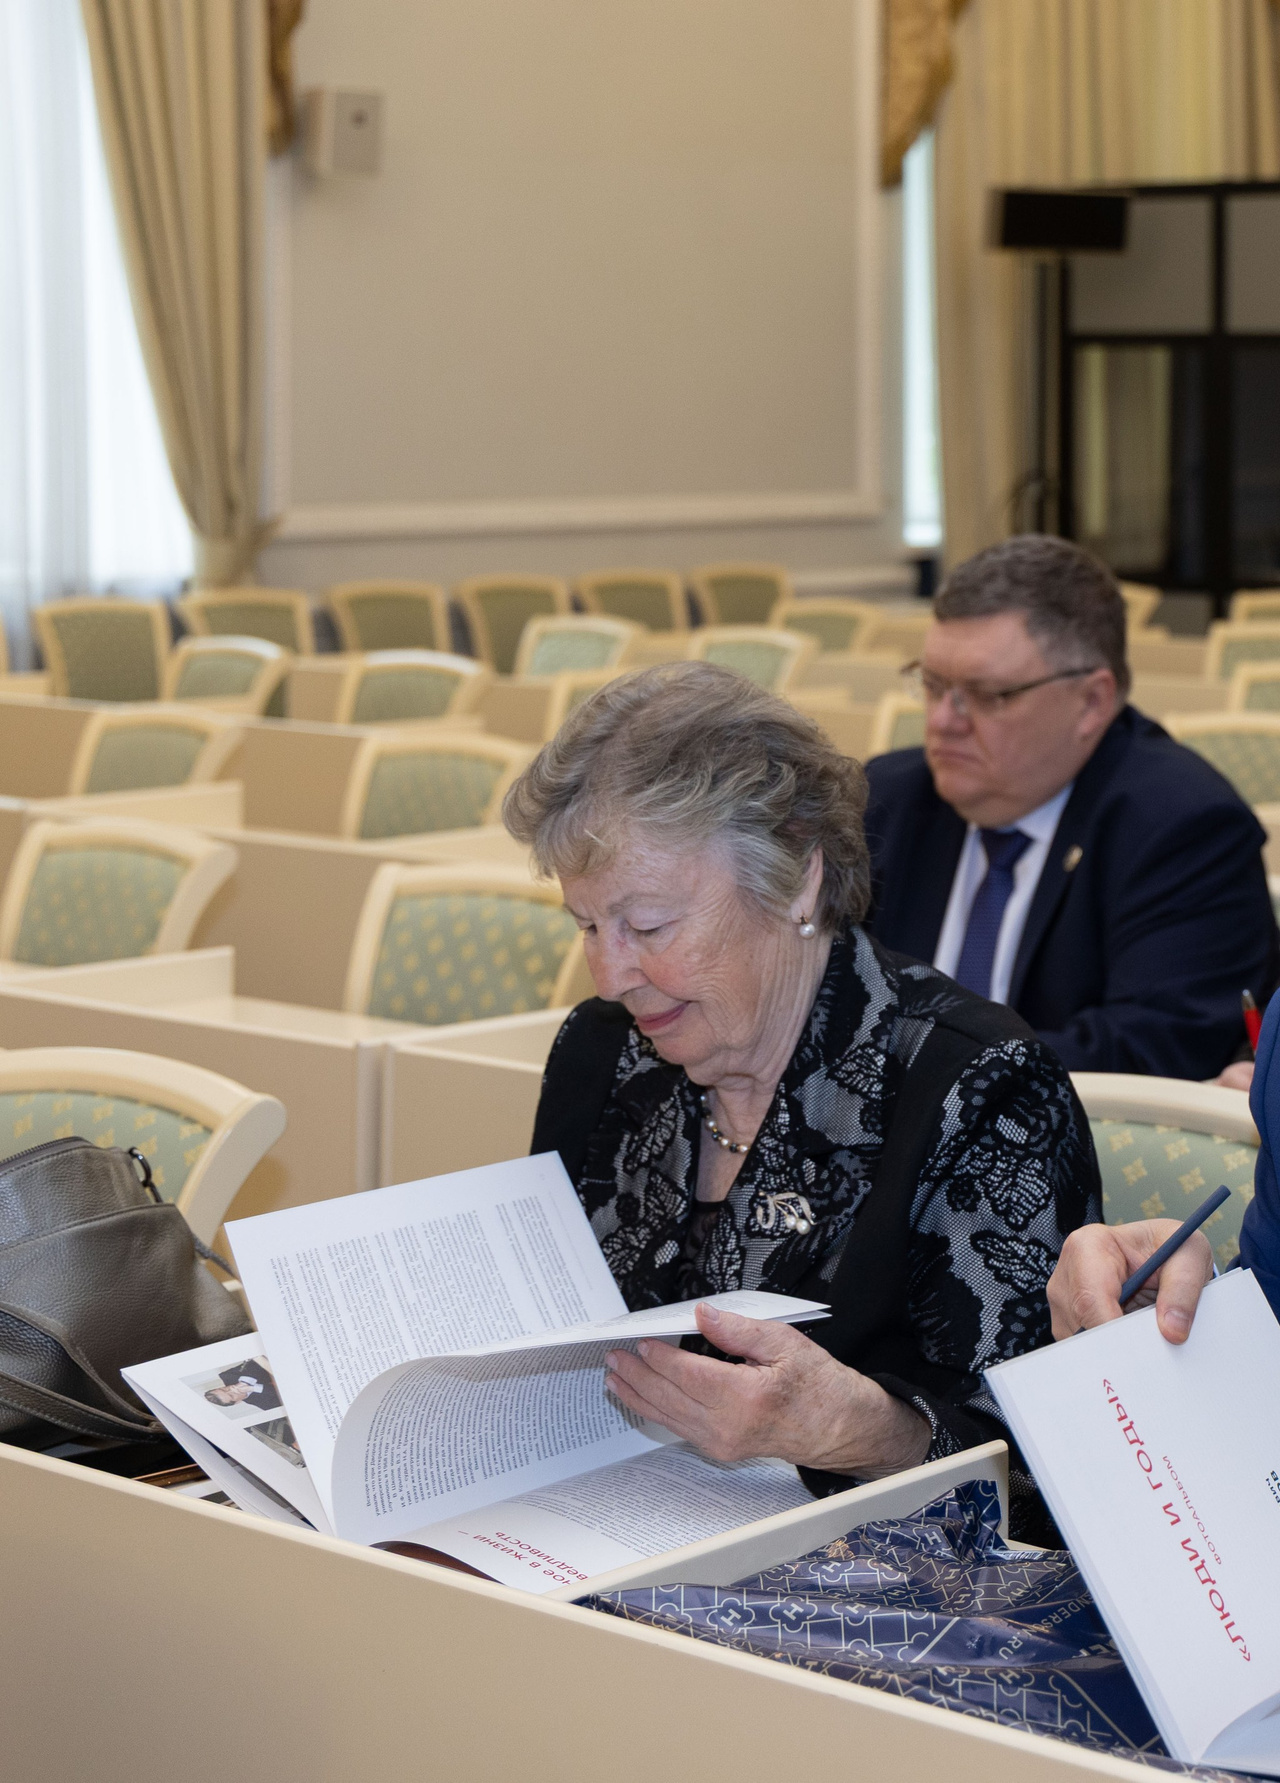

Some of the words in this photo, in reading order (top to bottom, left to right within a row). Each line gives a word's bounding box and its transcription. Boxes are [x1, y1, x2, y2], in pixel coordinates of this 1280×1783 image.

[1102, 1378, 1163, 1490] ГОДЫ»
[1162, 1455, 1222, 1565] ФОТОАЛЬБОМ
[1162, 1502, 1181, 1526] И
[473, 1534, 528, 1561] жизни
[495, 1531, 589, 1581] ведливость
[529, 1561, 542, 1569] в
[1180, 1537, 1251, 1662] «ЛЮДИ
